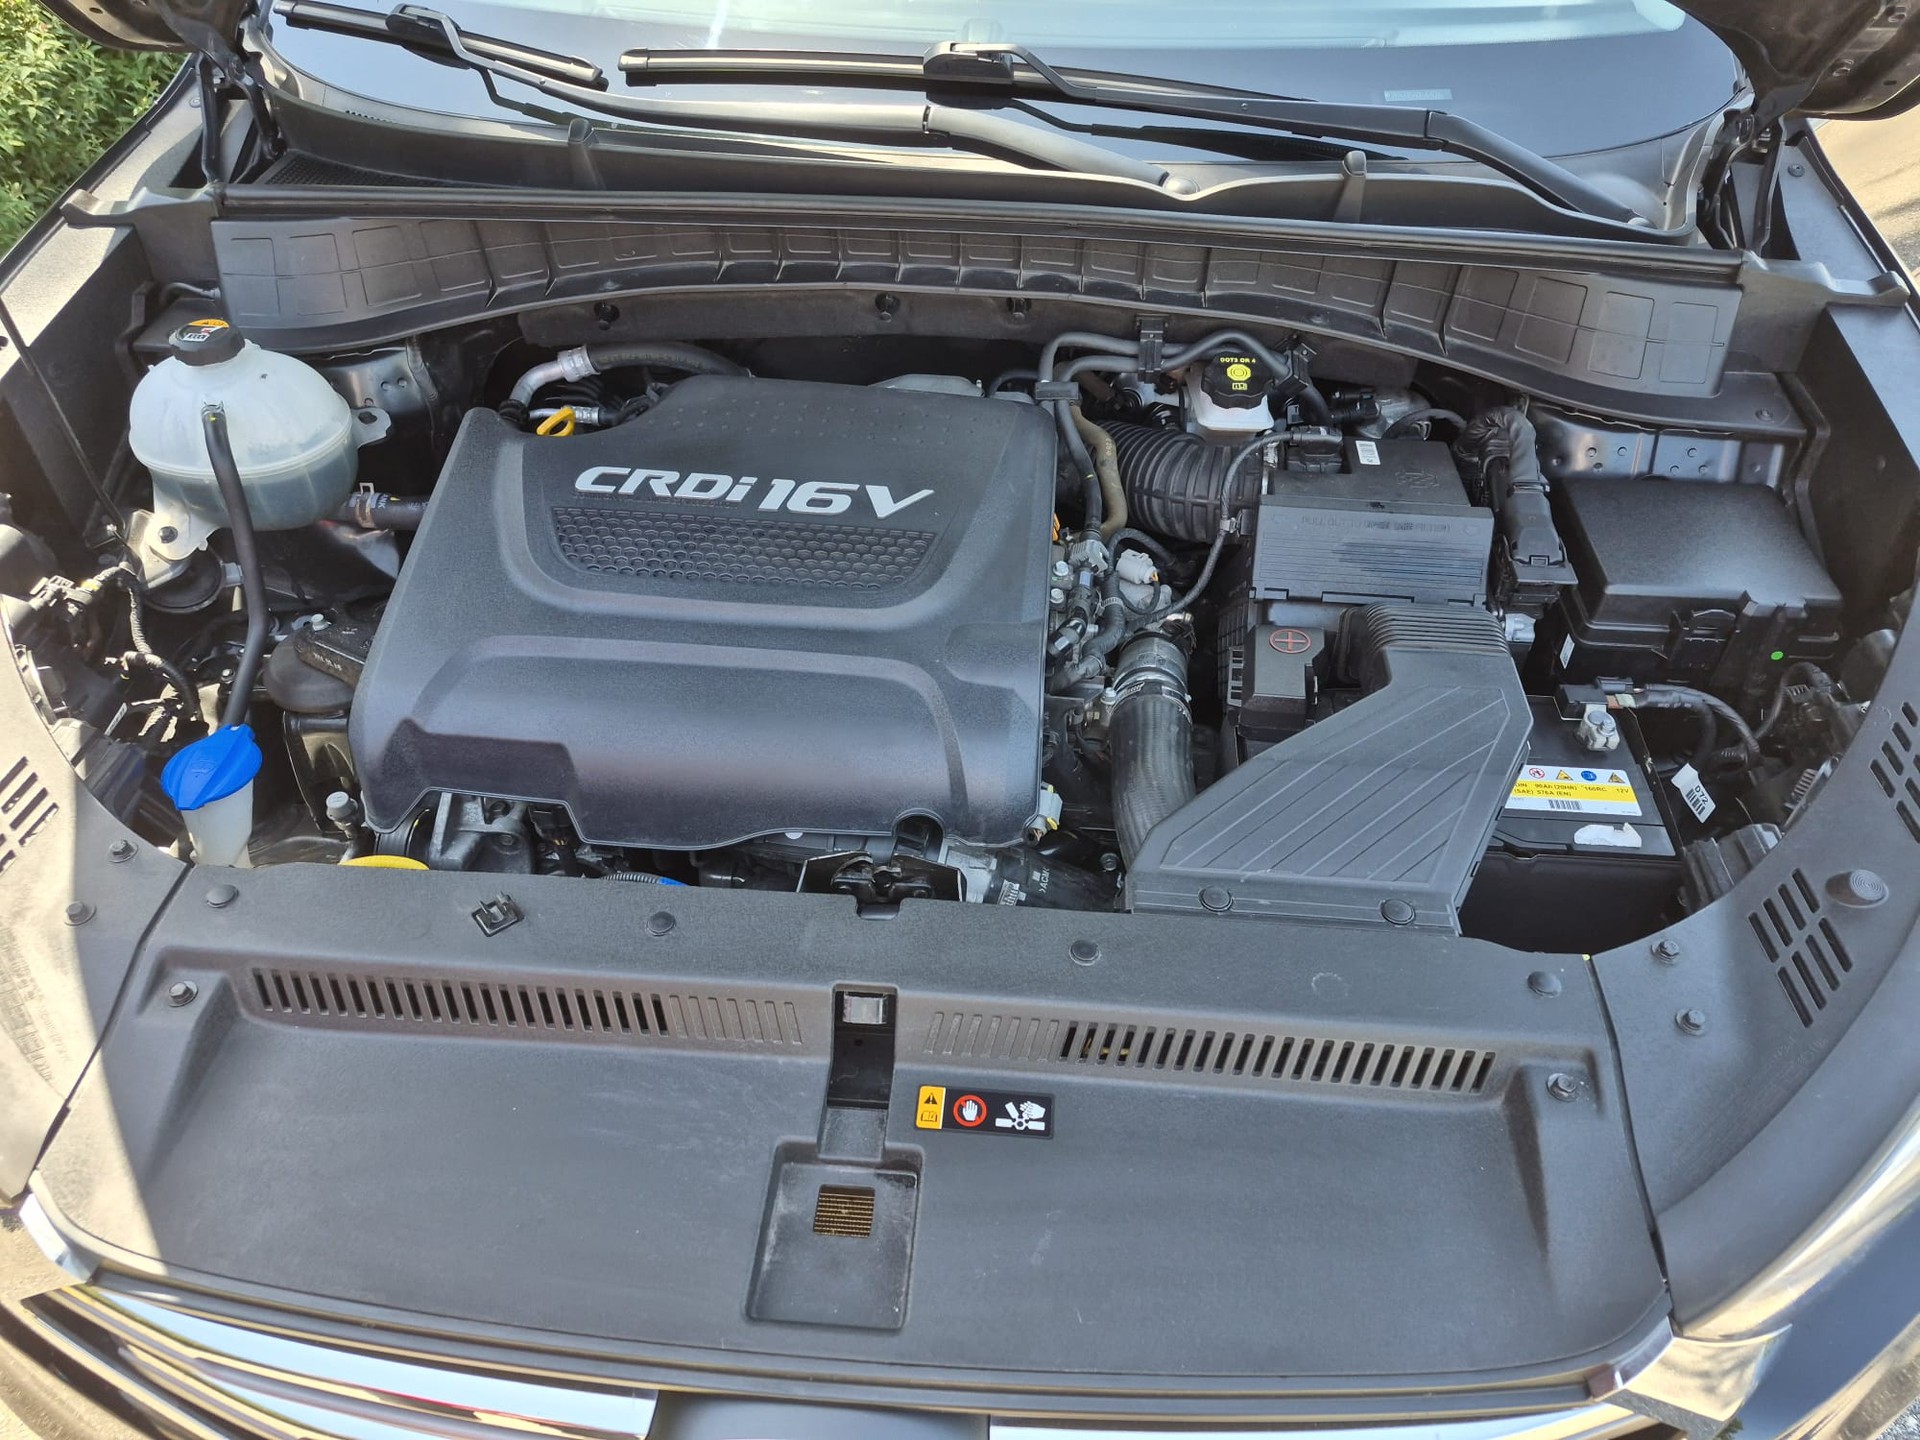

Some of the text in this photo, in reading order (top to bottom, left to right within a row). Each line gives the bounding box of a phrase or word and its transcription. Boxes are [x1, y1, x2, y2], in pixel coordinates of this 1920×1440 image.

[574, 465, 935, 519] CRDi 16V
[1694, 785, 1709, 806] D72
